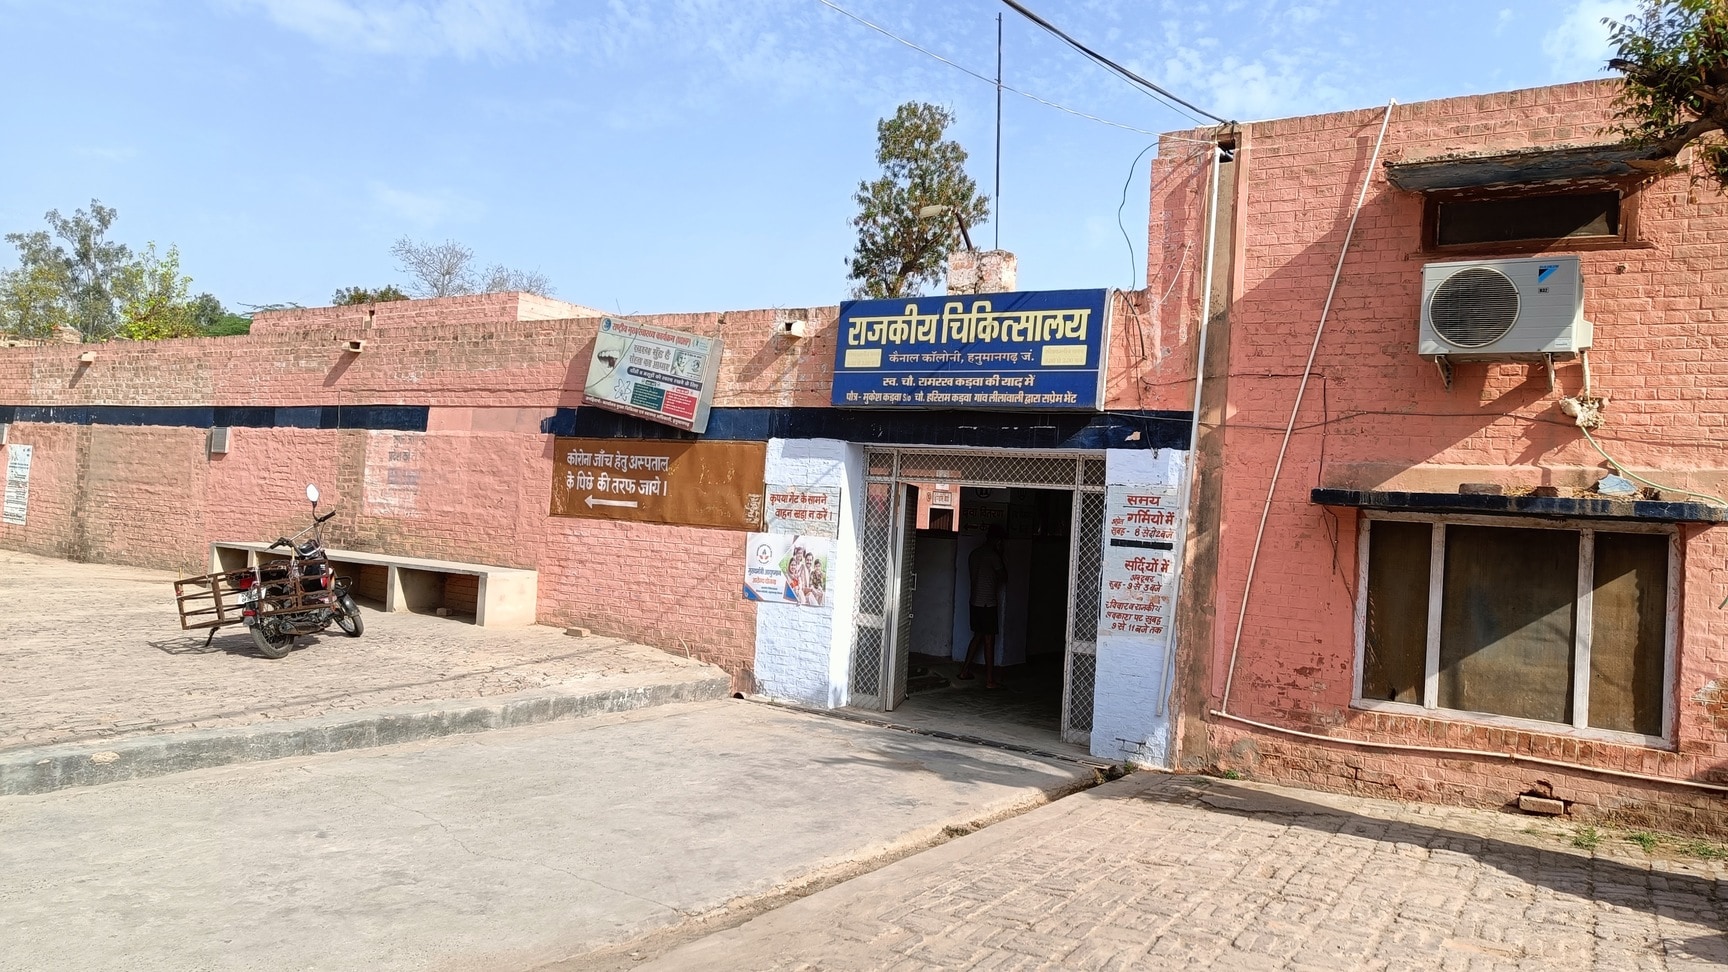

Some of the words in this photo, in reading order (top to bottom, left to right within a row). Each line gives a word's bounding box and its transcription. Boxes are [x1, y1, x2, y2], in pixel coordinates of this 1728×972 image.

[849, 304, 939, 345] राजकीय
[941, 301, 1091, 344] चिकित्सालय
[889, 351, 920, 362] कैनाल
[922, 351, 964, 364] कॉलोनी,
[968, 352, 1018, 365] हनुमानगढ़
[883, 377, 898, 387] स्व.
[902, 375, 916, 386] चौ.
[955, 377, 984, 389] कड़वा
[985, 374, 1000, 387] की
[1001, 377, 1023, 388] याद
[1024, 374, 1035, 387] में
[863, 392, 882, 404] मुकेश
[1025, 393, 1041, 404] द्वारा
[1042, 391, 1063, 404] सप्रेम
[1064, 391, 1078, 403] भेंट
[567, 449, 592, 466] कोरोना
[593, 449, 614, 468] जाँच
[614, 451, 628, 472] हेतु
[629, 455, 670, 472] अस्पताल
[566, 471, 575, 489] के
[576, 471, 594, 490] पिछे
[597, 472, 611, 492] की
[611, 478, 636, 494] तरफ
[770, 494, 789, 505] कृपया
[789, 492, 800, 503] गेट
[800, 493, 807, 504] के
[807, 493, 828, 505] सामने
[1127, 496, 1161, 506] समय
[775, 508, 792, 519] वाहन
[809, 511, 816, 519] न
[980, 506, 1004, 518] वितरण
[1166, 512, 1175, 525] में
[1135, 528, 1140, 537] 8
[1125, 557, 1159, 573] सर्दियों
[1161, 559, 1170, 573] में
[1133, 581, 1142, 591] से
[1150, 582, 1162, 592] बजे
[1134, 614, 1144, 622] पर
[1146, 615, 1163, 625] सुबह
[1118, 620, 1126, 630] से
[1135, 623, 1149, 633] बजे
[1150, 626, 1163, 634] तक
